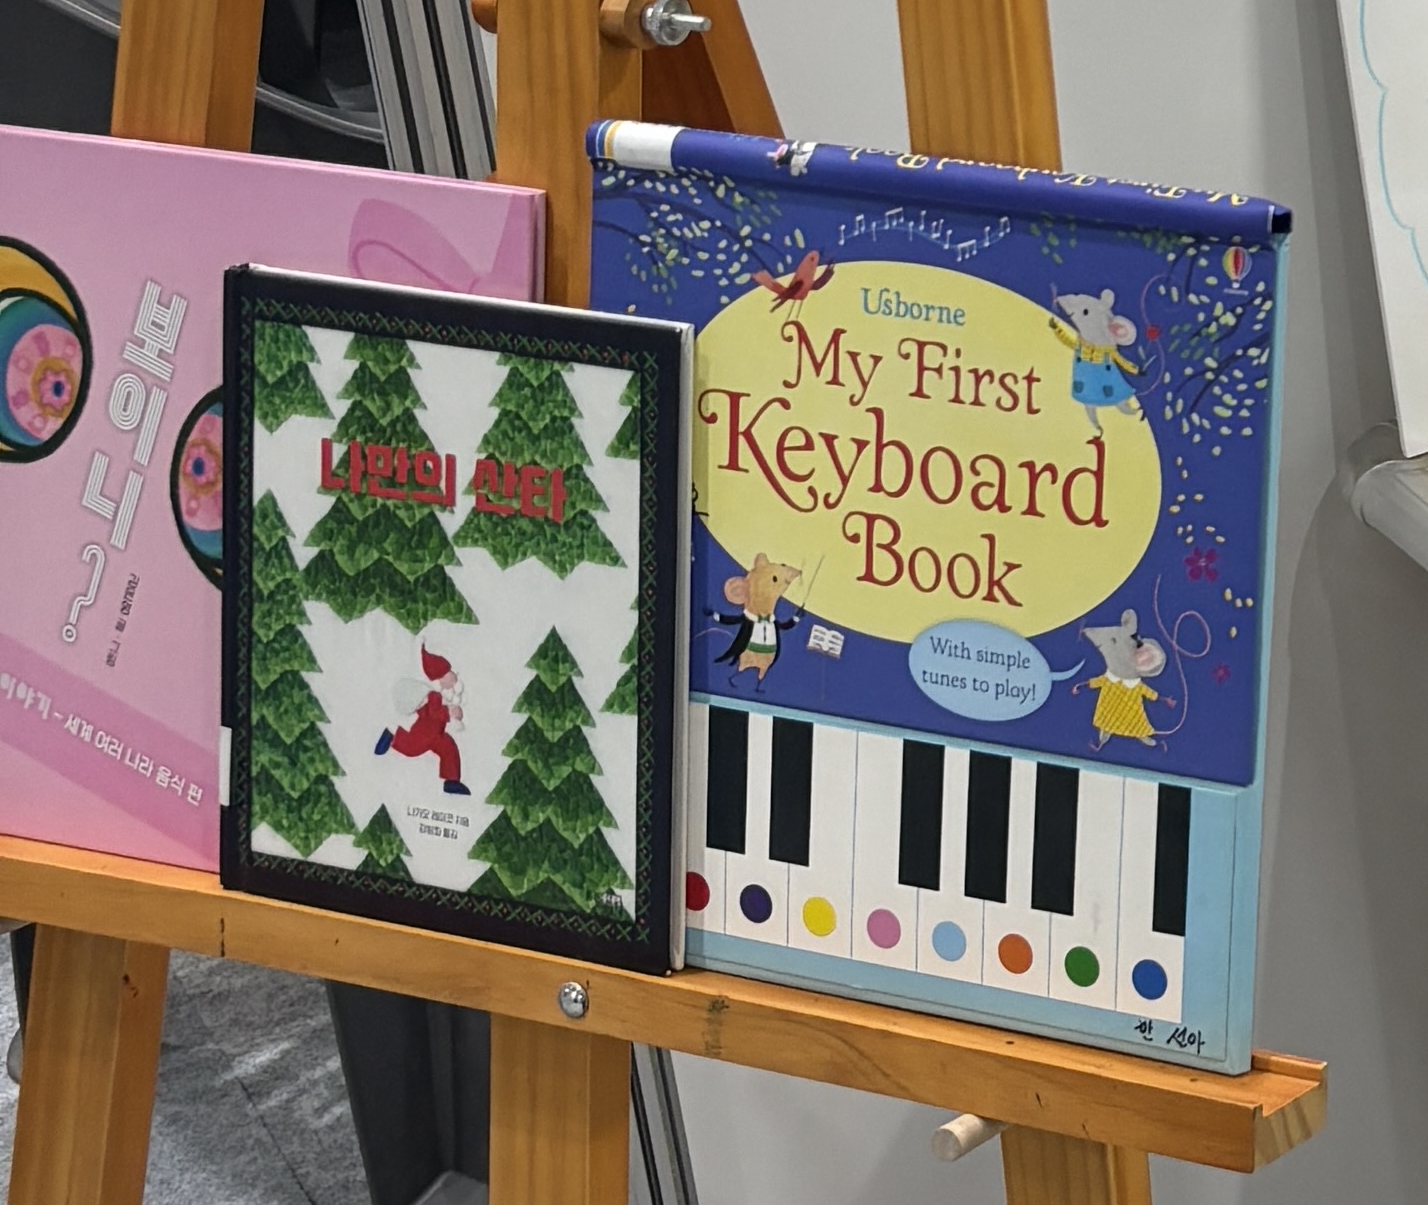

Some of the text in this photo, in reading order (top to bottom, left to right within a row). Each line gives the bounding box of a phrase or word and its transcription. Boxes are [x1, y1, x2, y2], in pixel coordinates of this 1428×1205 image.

[860, 286, 967, 327] Usborne
[780, 319, 1042, 416] My First
[319, 438, 569, 524] 나만의 산타
[697, 387, 1111, 529] Keyboard
[841, 511, 1024, 608] Book
[921, 669, 1038, 703] tunes to play!
[929, 635, 1032, 675] With simple
[0, 672, 204, 807] 이야기 세계 여러 나라 음식 편
